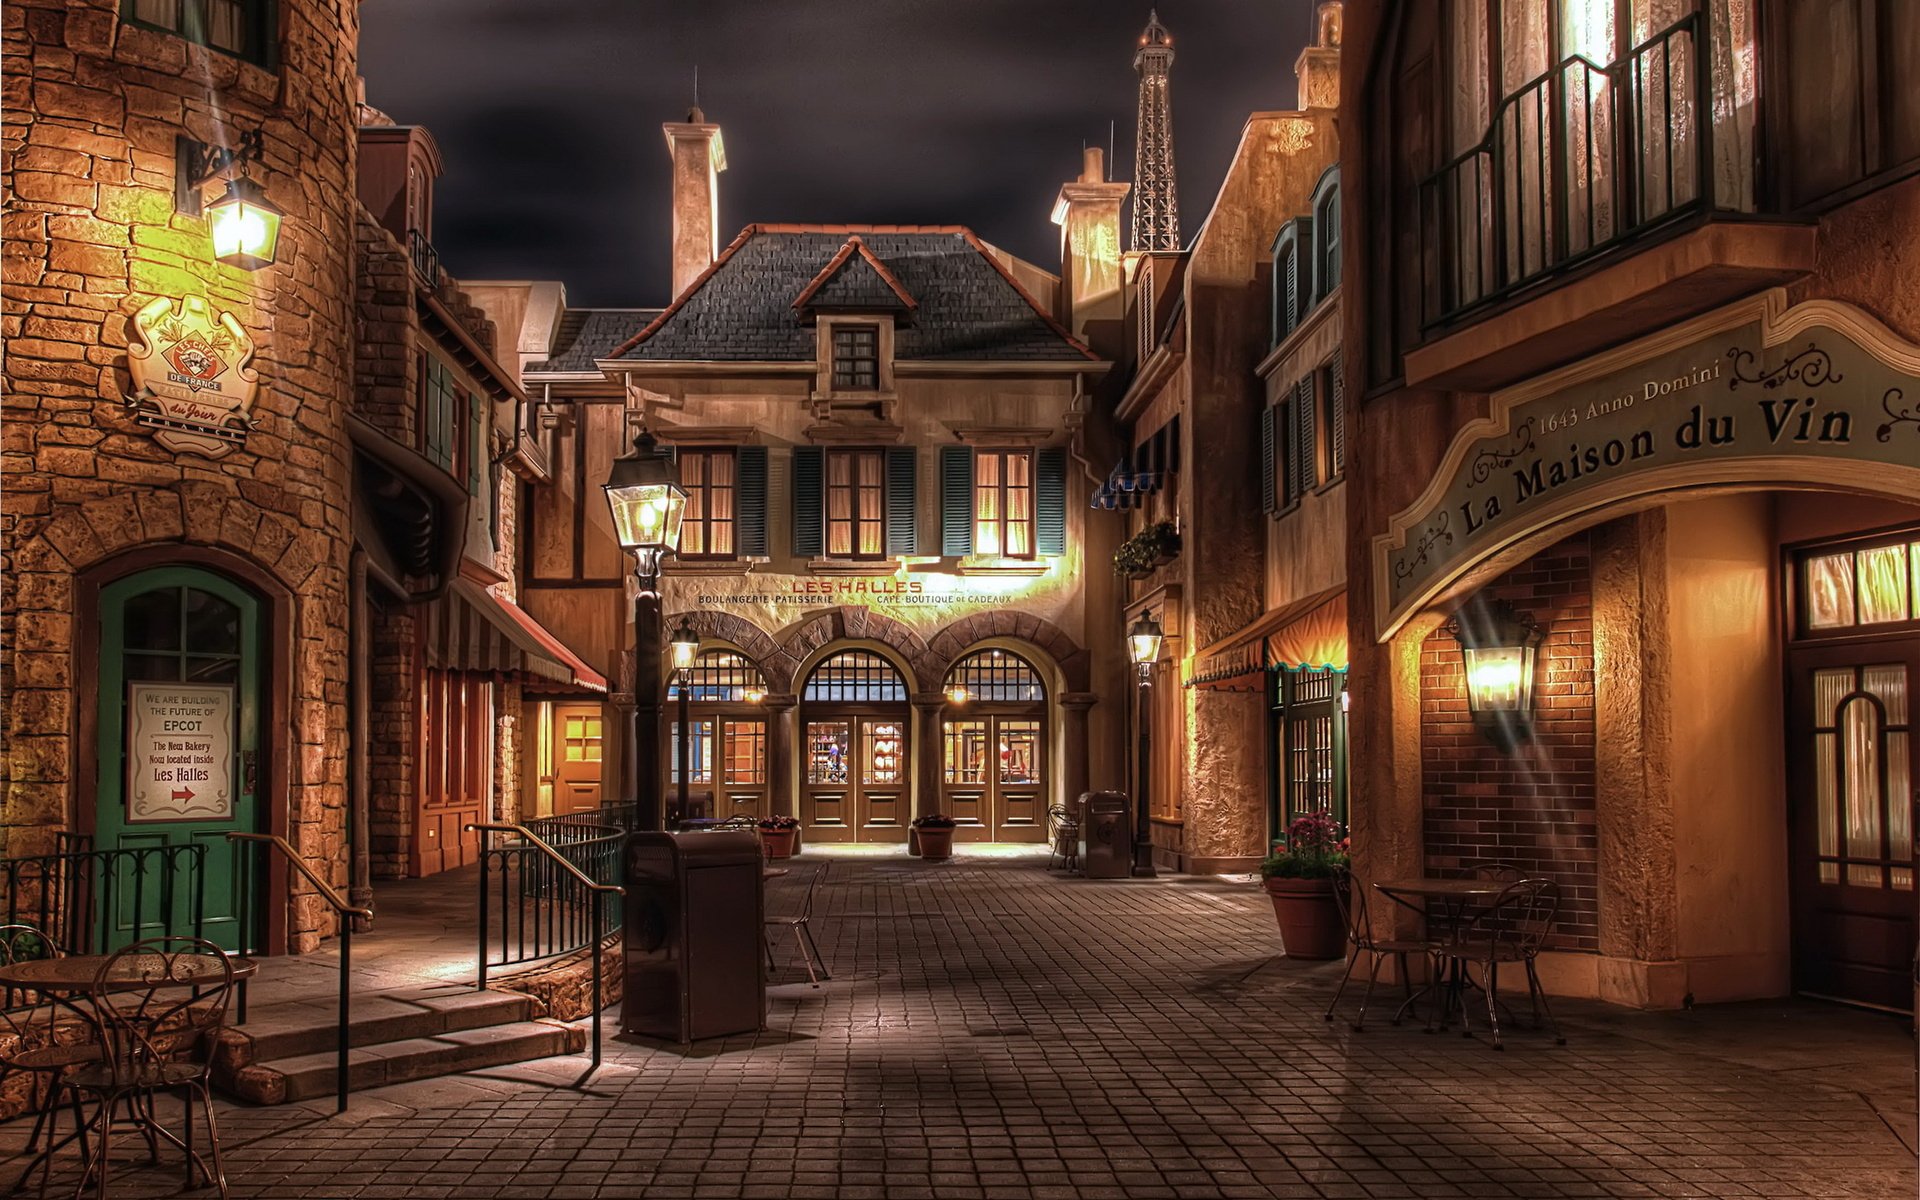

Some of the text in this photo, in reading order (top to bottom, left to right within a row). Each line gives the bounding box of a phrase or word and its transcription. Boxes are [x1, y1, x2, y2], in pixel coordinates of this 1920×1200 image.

[175, 340, 216, 362] LES CHEFS
[170, 374, 220, 391] DE FRANCE
[1539, 358, 1721, 436] 1643 Anno Domini
[170, 403, 217, 421] du Jour
[148, 417, 236, 439] FRANCE
[1460, 397, 1852, 537] La Maison du Vin
[792, 581, 923, 594] LES HALLES
[698, 595, 834, 604] BOULANGERIE PATISSERIE
[905, 595, 954, 604] BOUTIQUE
[967, 595, 1012, 603] CADEAUX
[162, 695, 179, 704] ARE
[181, 696, 220, 705] BUILDING
[150, 707, 216, 717] THE FUTURE OF
[164, 720, 203, 732] EPCOT
[153, 741, 211, 753] The New Bakery
[149, 754, 214, 764] Now located inside
[154, 767, 209, 783] Les Halles
